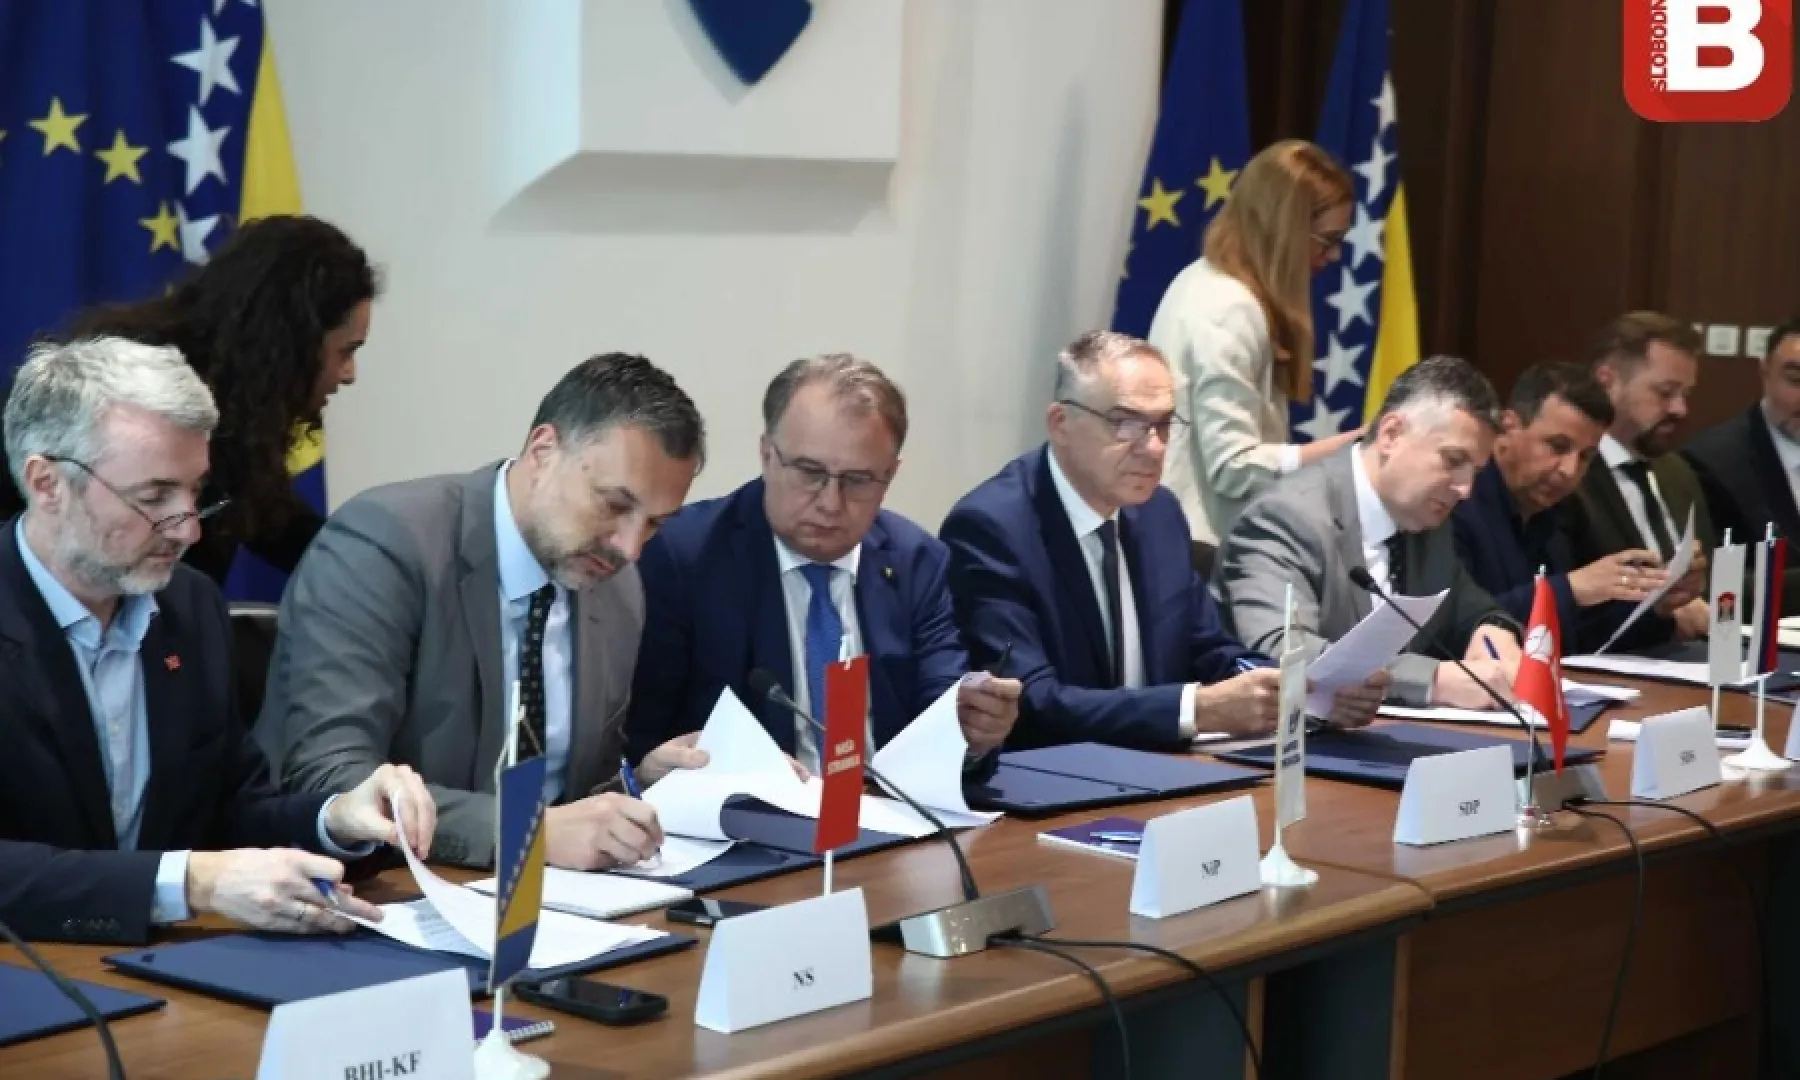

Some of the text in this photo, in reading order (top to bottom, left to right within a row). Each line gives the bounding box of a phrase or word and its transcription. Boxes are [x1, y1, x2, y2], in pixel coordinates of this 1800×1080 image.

[1458, 798, 1480, 817] SDP
[793, 966, 814, 992] NS
[344, 1050, 421, 1080] BHI-KF
